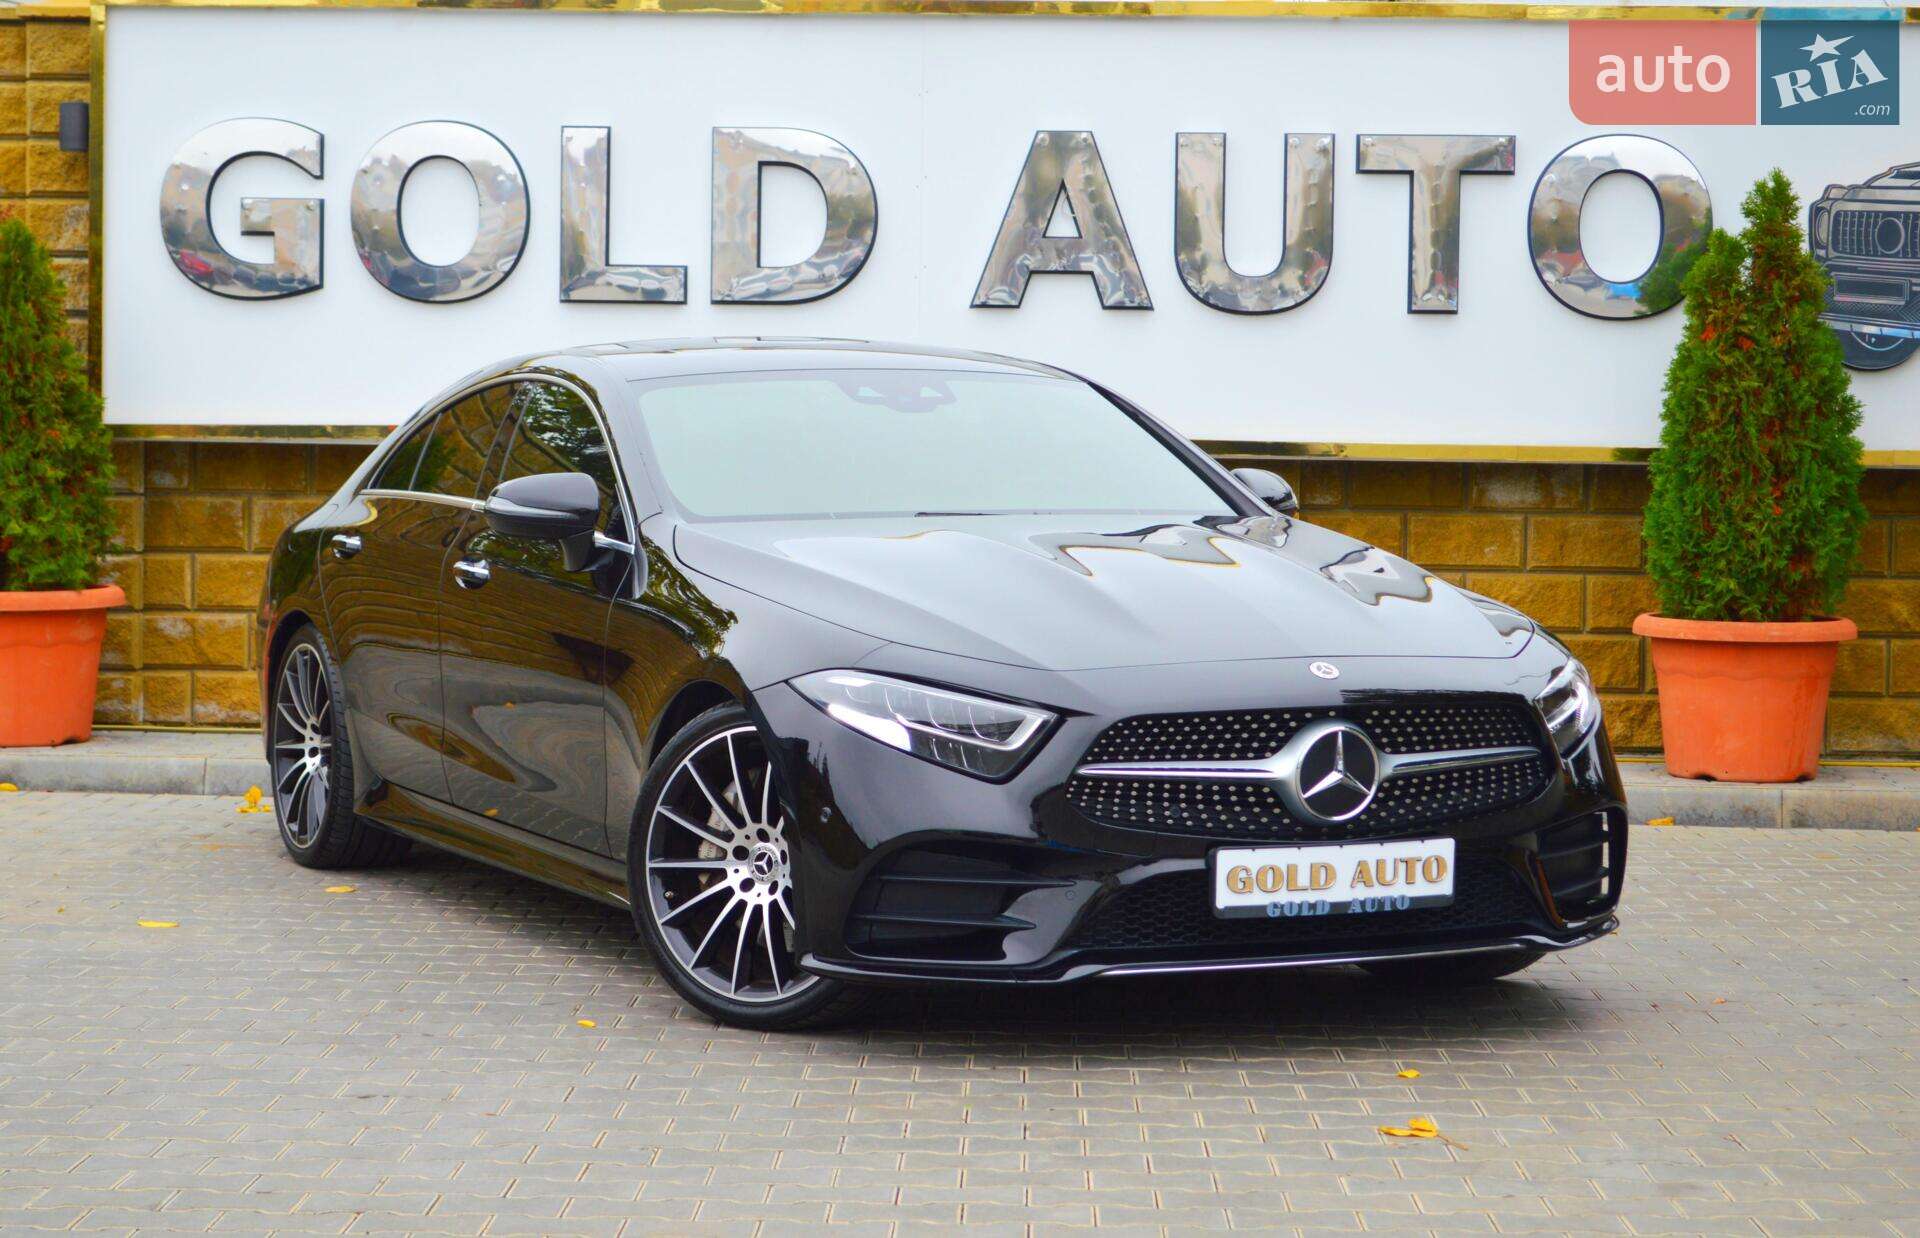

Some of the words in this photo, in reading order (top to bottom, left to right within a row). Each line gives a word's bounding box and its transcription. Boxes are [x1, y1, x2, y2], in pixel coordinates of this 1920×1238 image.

[160, 117, 878, 304] GOLD
[970, 130, 1713, 320] AUTO
[1227, 863, 1337, 894] GOLD
[1350, 855, 1448, 886] AUTO
[1267, 900, 1331, 917] GOLD
[1347, 895, 1411, 914] AUTO
